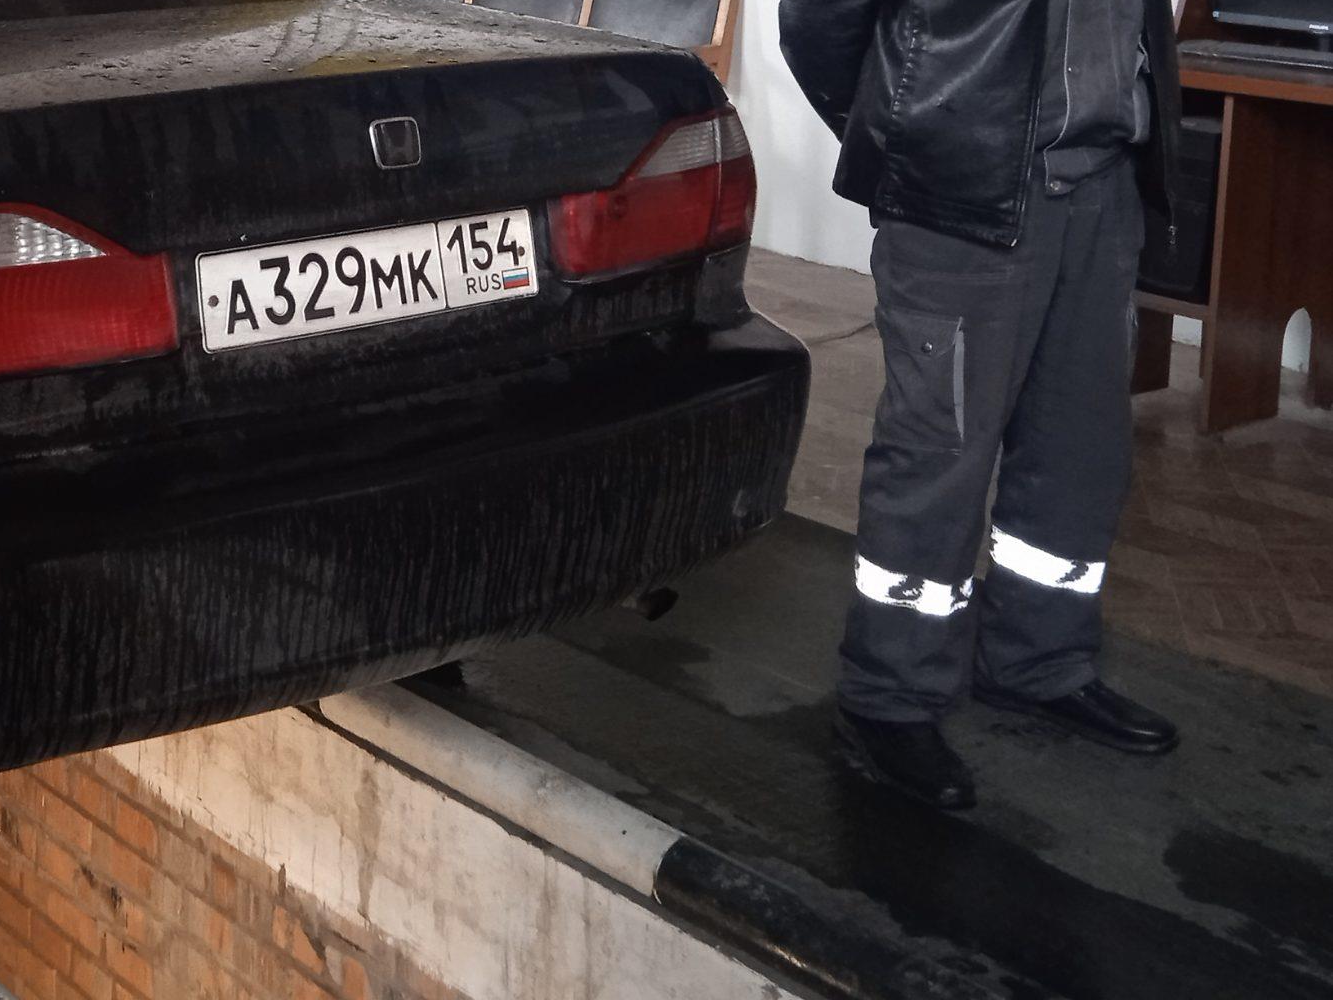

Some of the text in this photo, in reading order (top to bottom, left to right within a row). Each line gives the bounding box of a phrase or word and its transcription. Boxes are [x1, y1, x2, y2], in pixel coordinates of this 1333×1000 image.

[227, 217, 519, 334] А329МК 154
[466, 272, 502, 295] RUS
